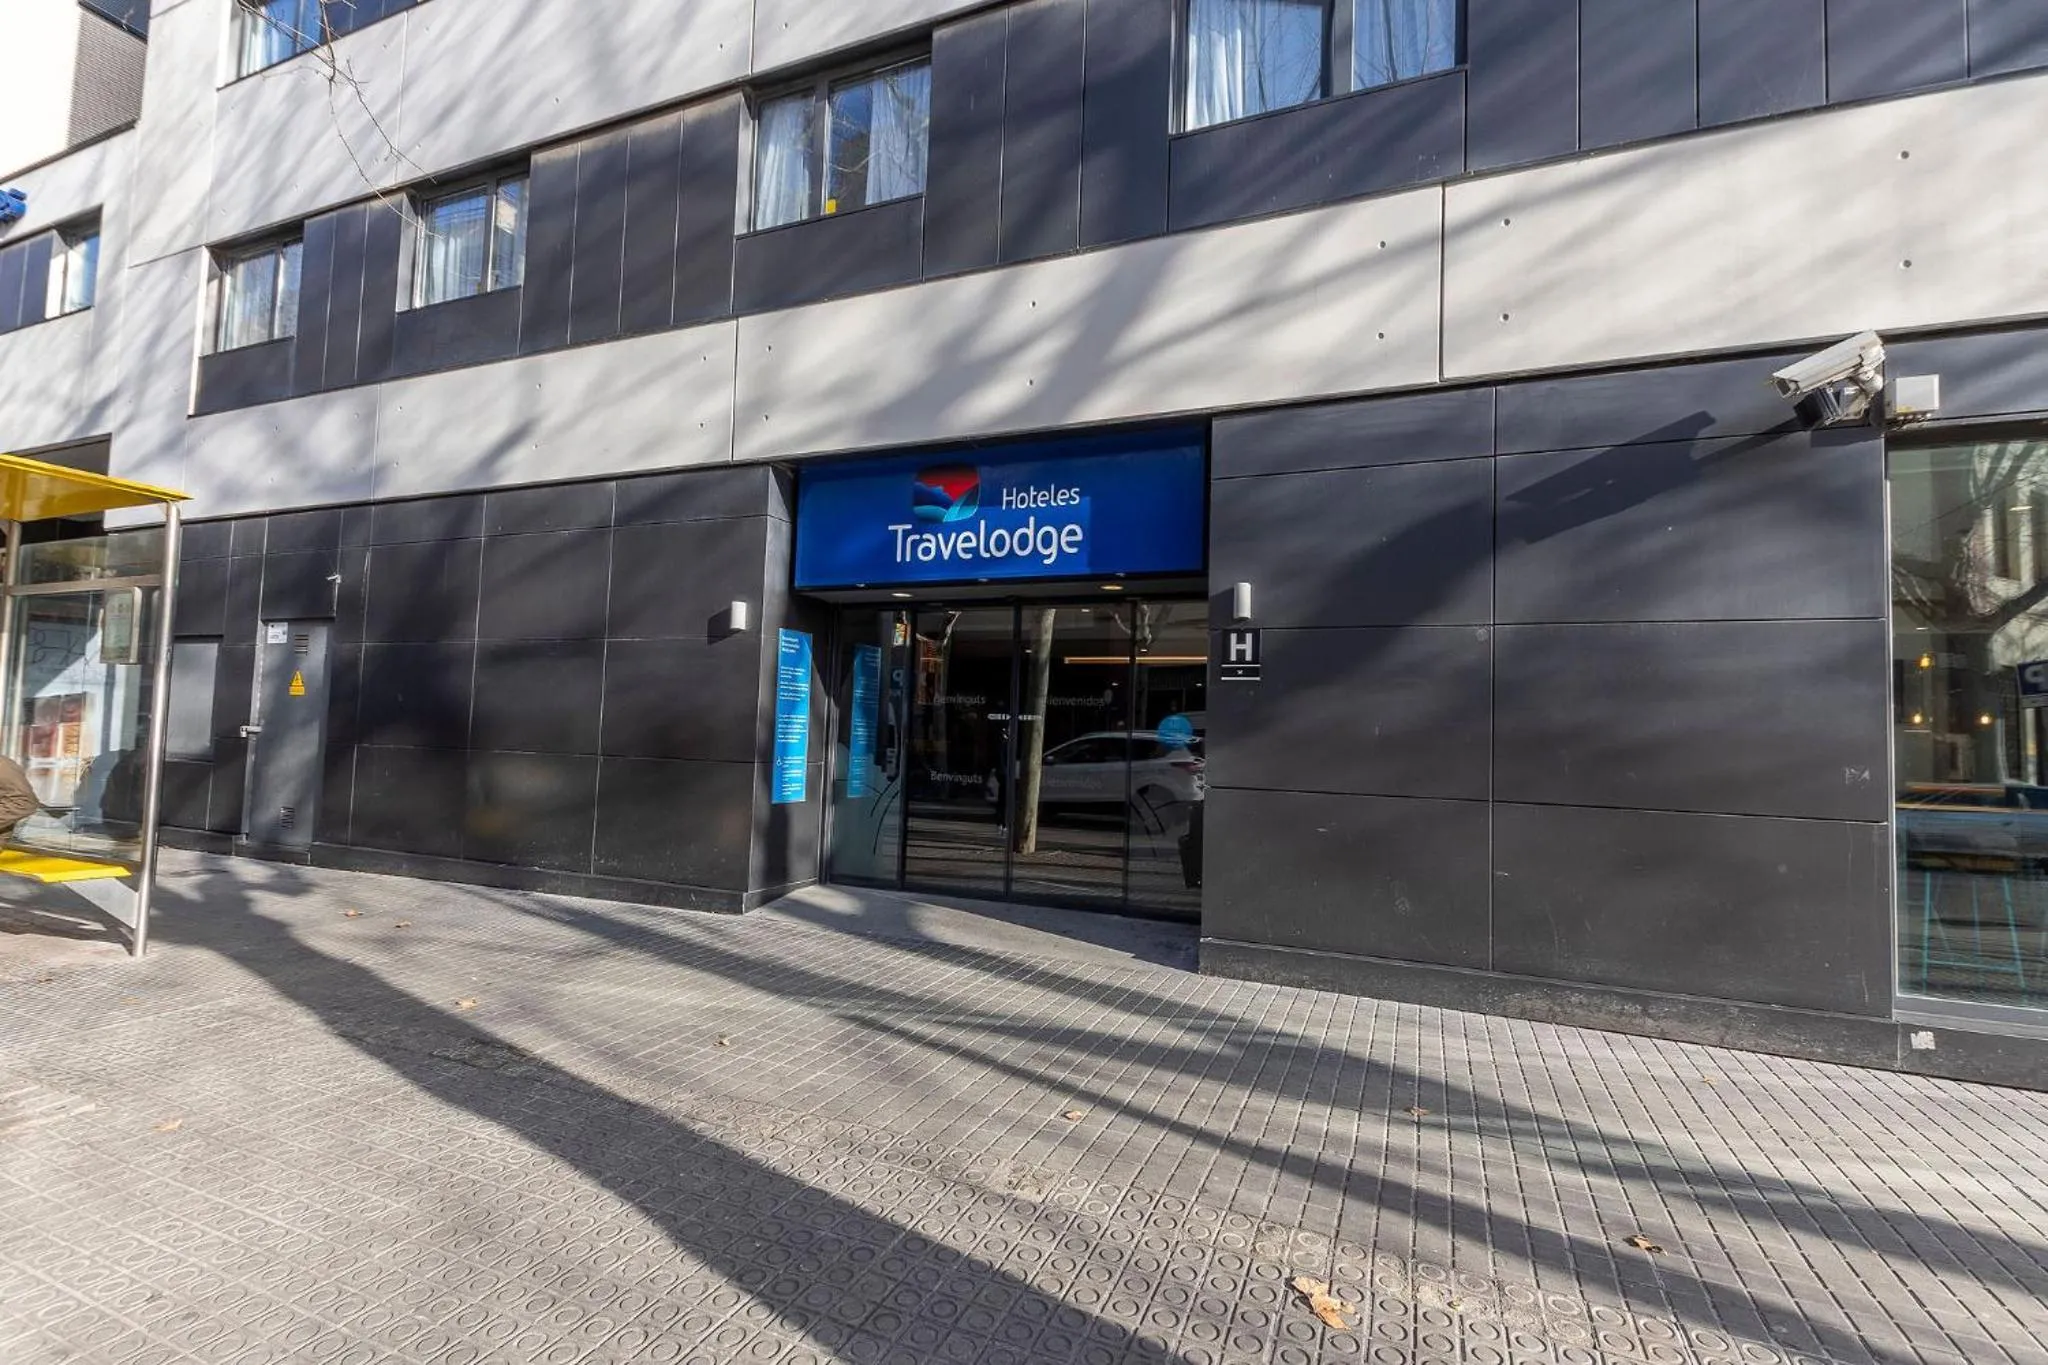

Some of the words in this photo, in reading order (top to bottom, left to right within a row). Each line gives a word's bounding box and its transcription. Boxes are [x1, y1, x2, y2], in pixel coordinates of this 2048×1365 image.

[1002, 484, 1080, 510] Hoteles
[888, 516, 1084, 565] Travelodge
[1230, 633, 1253, 661] H
